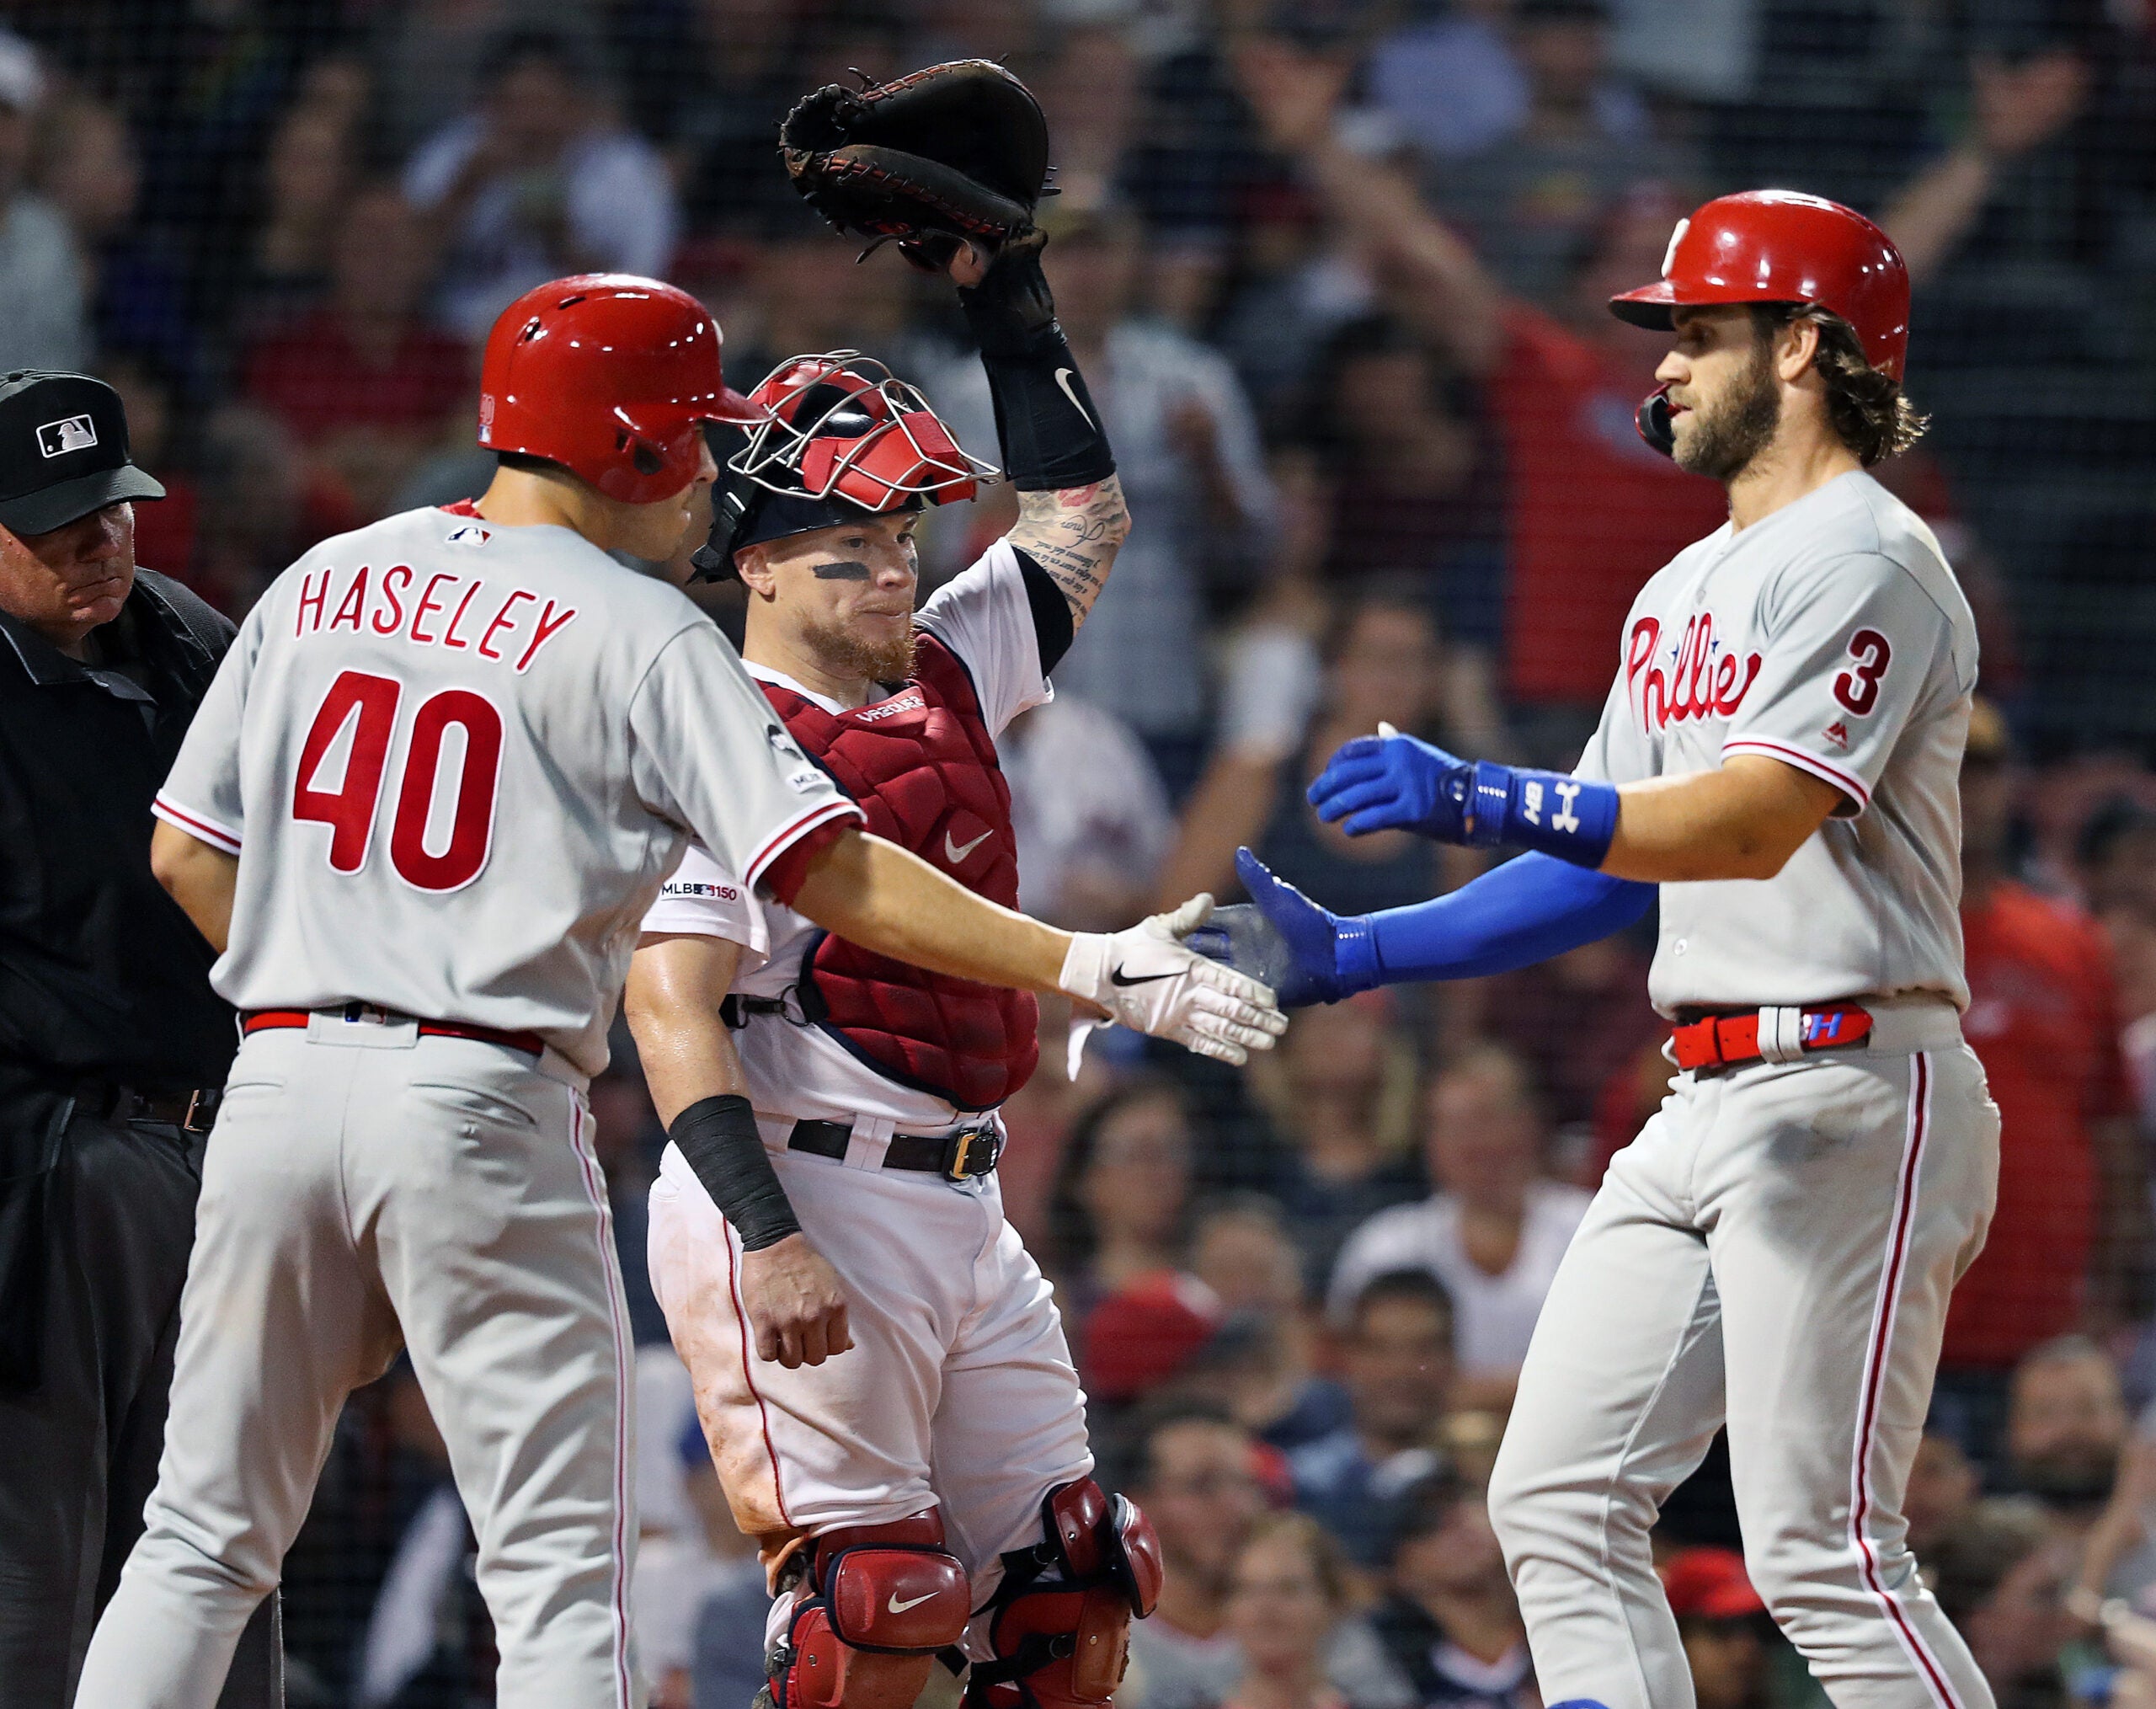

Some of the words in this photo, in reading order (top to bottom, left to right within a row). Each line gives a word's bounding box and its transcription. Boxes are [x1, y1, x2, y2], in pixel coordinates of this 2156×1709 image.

[295, 563, 579, 675] HASELEY
[1832, 628, 1893, 718] 3
[292, 670, 505, 894] 40
[661, 883, 692, 895] MLB
[714, 885, 737, 901] 150
